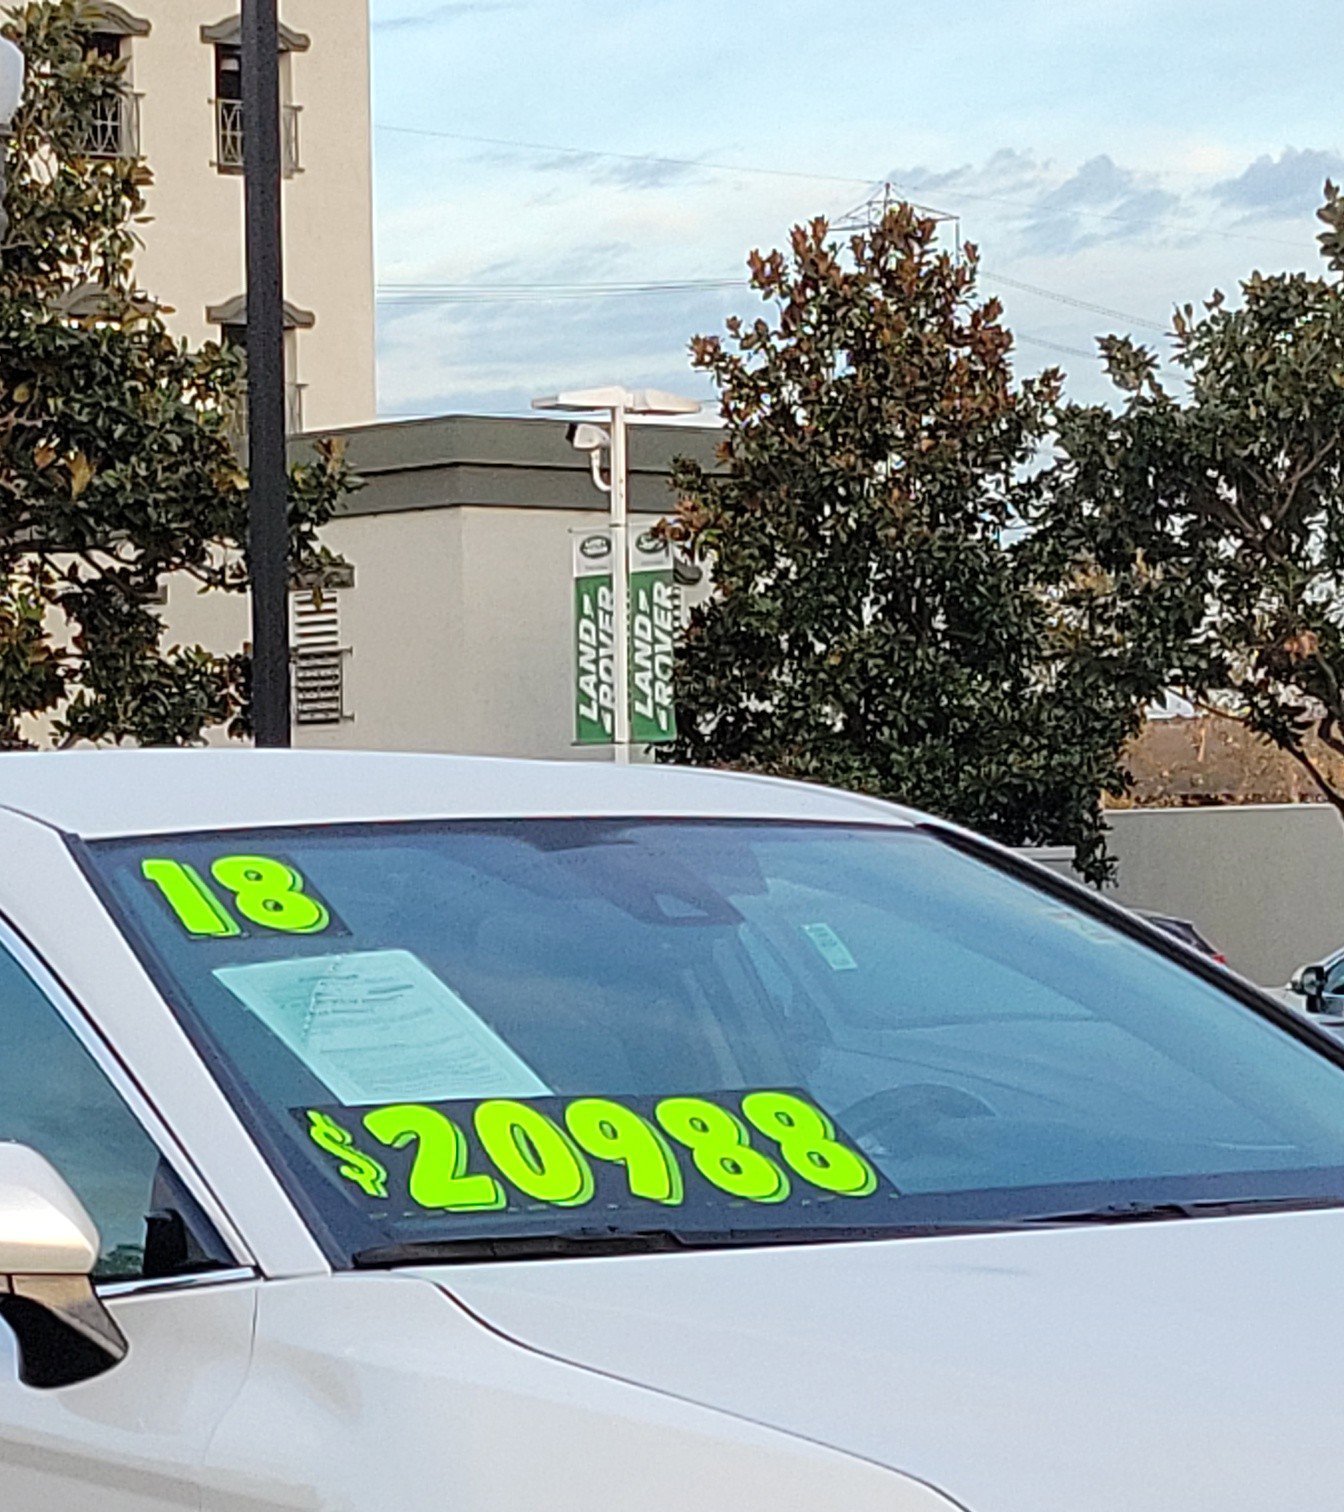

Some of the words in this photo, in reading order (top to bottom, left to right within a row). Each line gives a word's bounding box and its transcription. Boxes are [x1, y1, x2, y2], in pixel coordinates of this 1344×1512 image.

[578, 617, 598, 723] LAND
[633, 613, 654, 720] LAND
[652, 580, 674, 707] ROVER
[141, 854, 330, 937] 18
[308, 1092, 877, 1211] $20988
